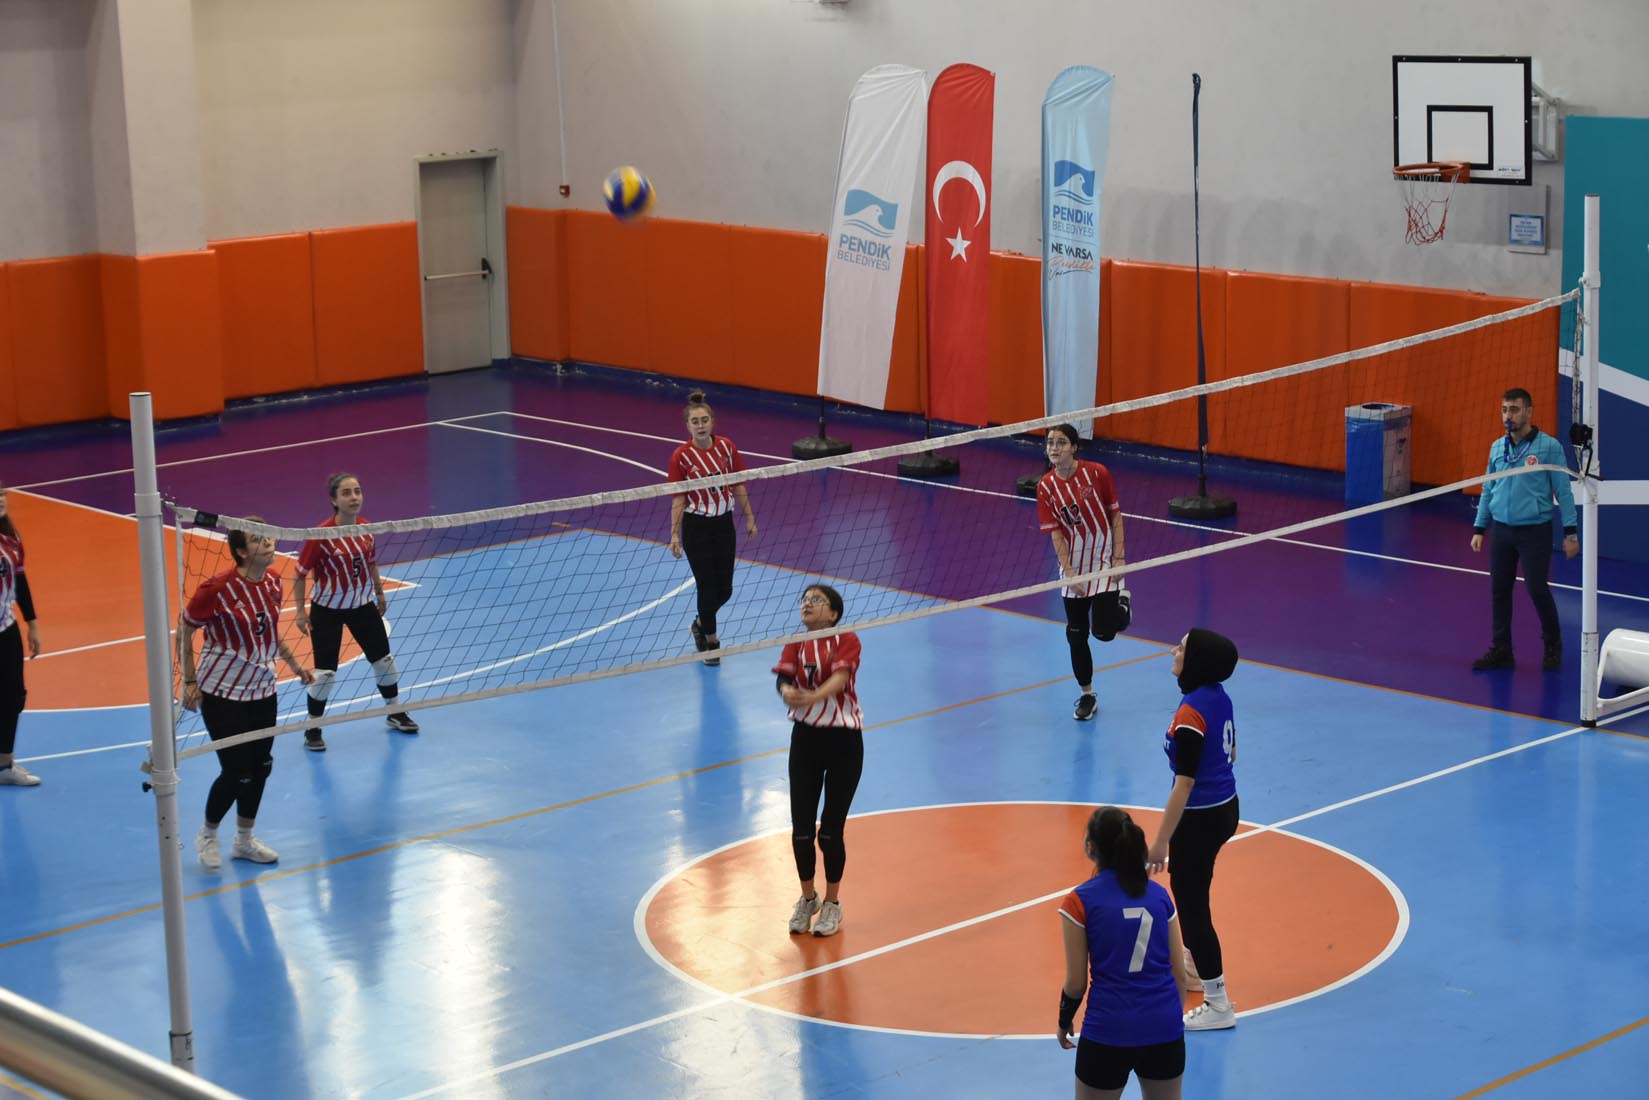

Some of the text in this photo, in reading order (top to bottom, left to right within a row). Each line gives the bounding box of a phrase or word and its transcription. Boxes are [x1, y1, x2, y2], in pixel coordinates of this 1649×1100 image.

[1051, 242, 1094, 261] NE VARSA
[1060, 503, 1082, 525] 12
[352, 557, 361, 578] 5
[255, 611, 268, 635] 3
[803, 663, 817, 686] 7
[1222, 719, 1233, 764] 9
[1122, 907, 1154, 973] 7
